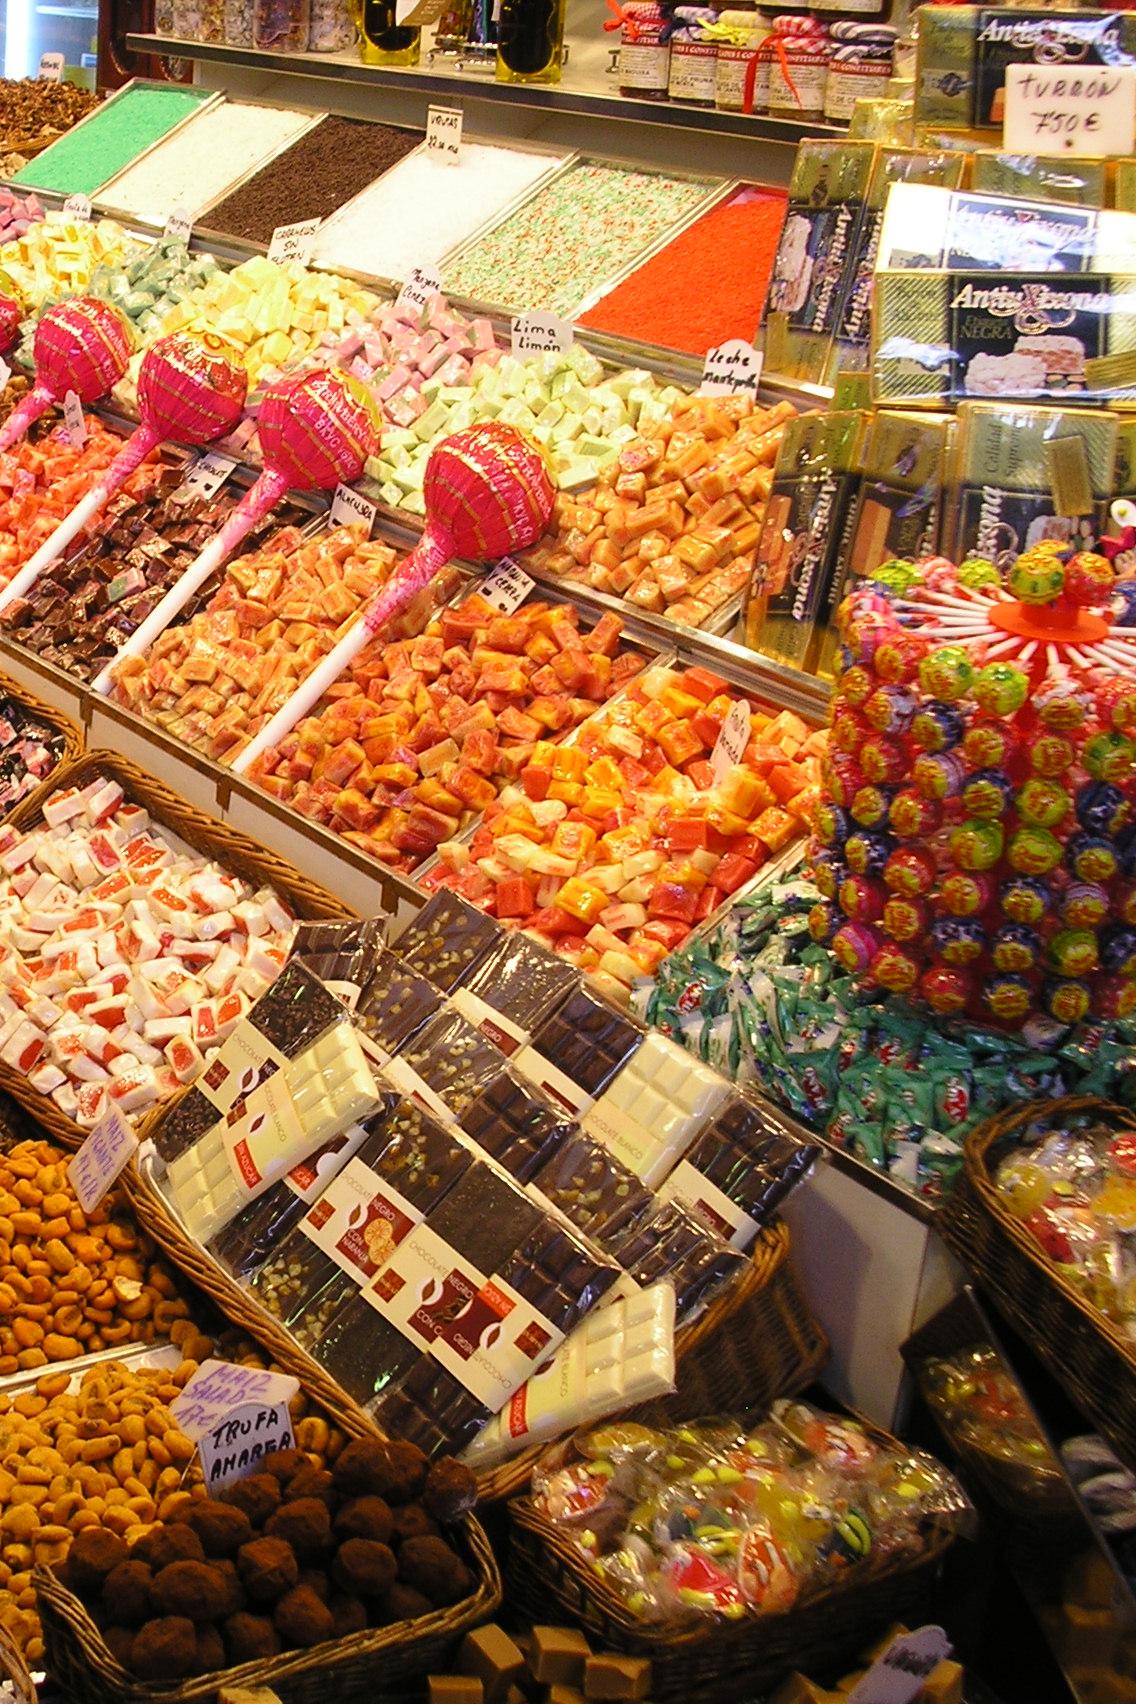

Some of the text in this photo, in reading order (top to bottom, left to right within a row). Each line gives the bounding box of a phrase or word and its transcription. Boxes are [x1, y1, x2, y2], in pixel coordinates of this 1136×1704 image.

[513, 319, 557, 338] Lima
[518, 336, 562, 352] Limón
[479, 1022, 504, 1044] NEGRO
[232, 1032, 265, 1064] CHOCOLATE
[340, 1171, 397, 1223] CHOCOLATE NEGRO
[347, 1228, 366, 1247] CON
[408, 1239, 475, 1301] CHOCOLATE NEGRO
[415, 1308, 435, 1328] CON
[452, 1331, 514, 1390] CHOCOLATE NEGRO
[212, 1408, 279, 1450] TRUFA
